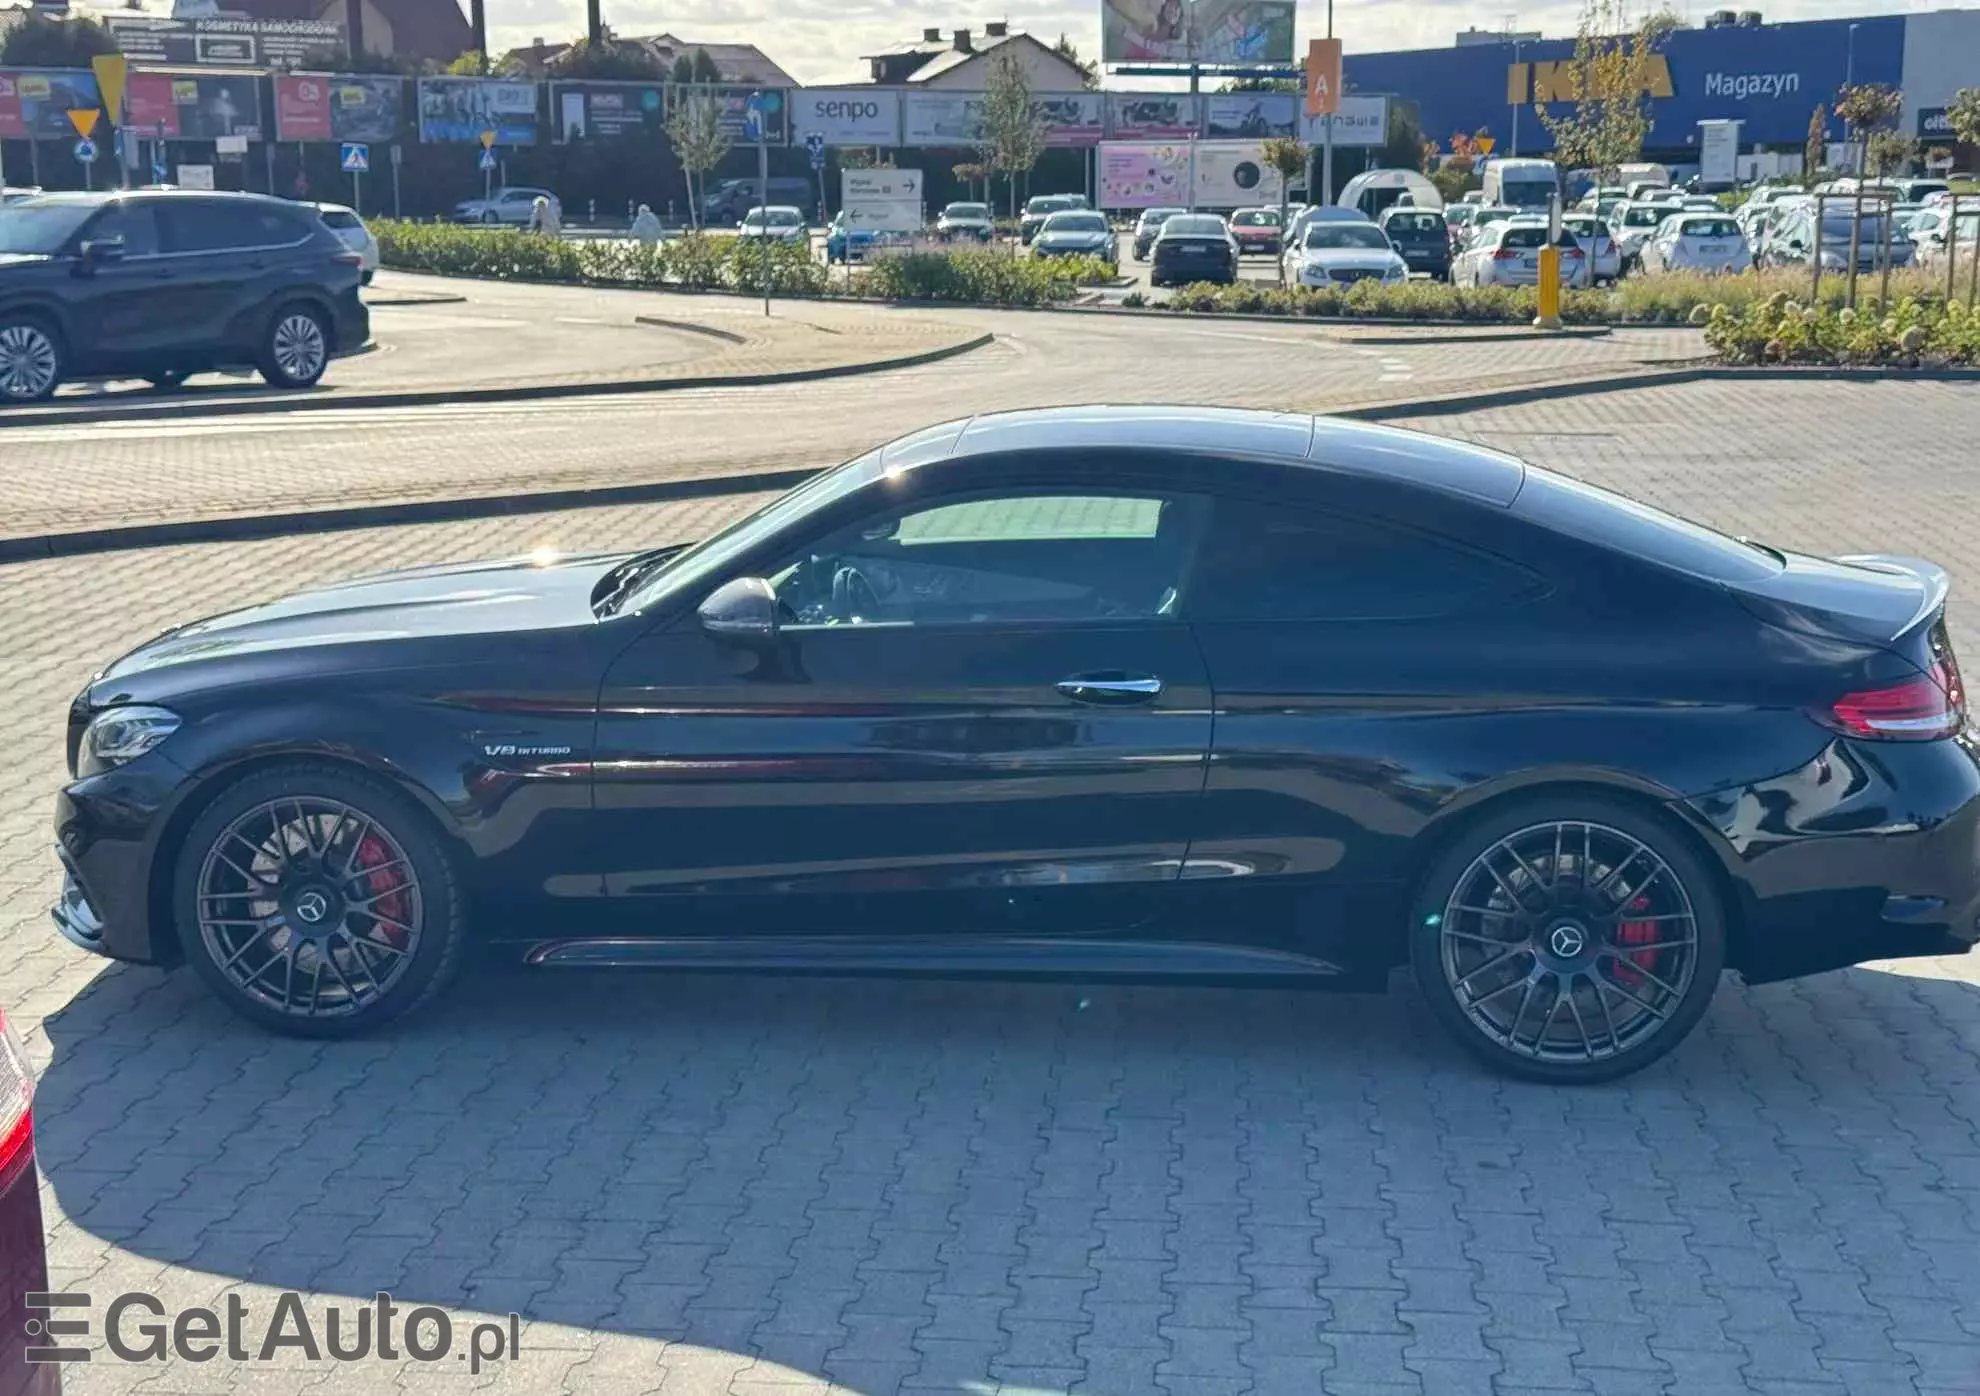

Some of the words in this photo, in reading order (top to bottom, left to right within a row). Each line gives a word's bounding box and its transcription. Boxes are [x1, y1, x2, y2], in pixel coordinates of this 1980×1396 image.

[1314, 73, 1329, 96] A
[1704, 72, 1799, 100] Magazyn
[815, 99, 878, 122] senpo
[484, 745, 516, 756] V8
